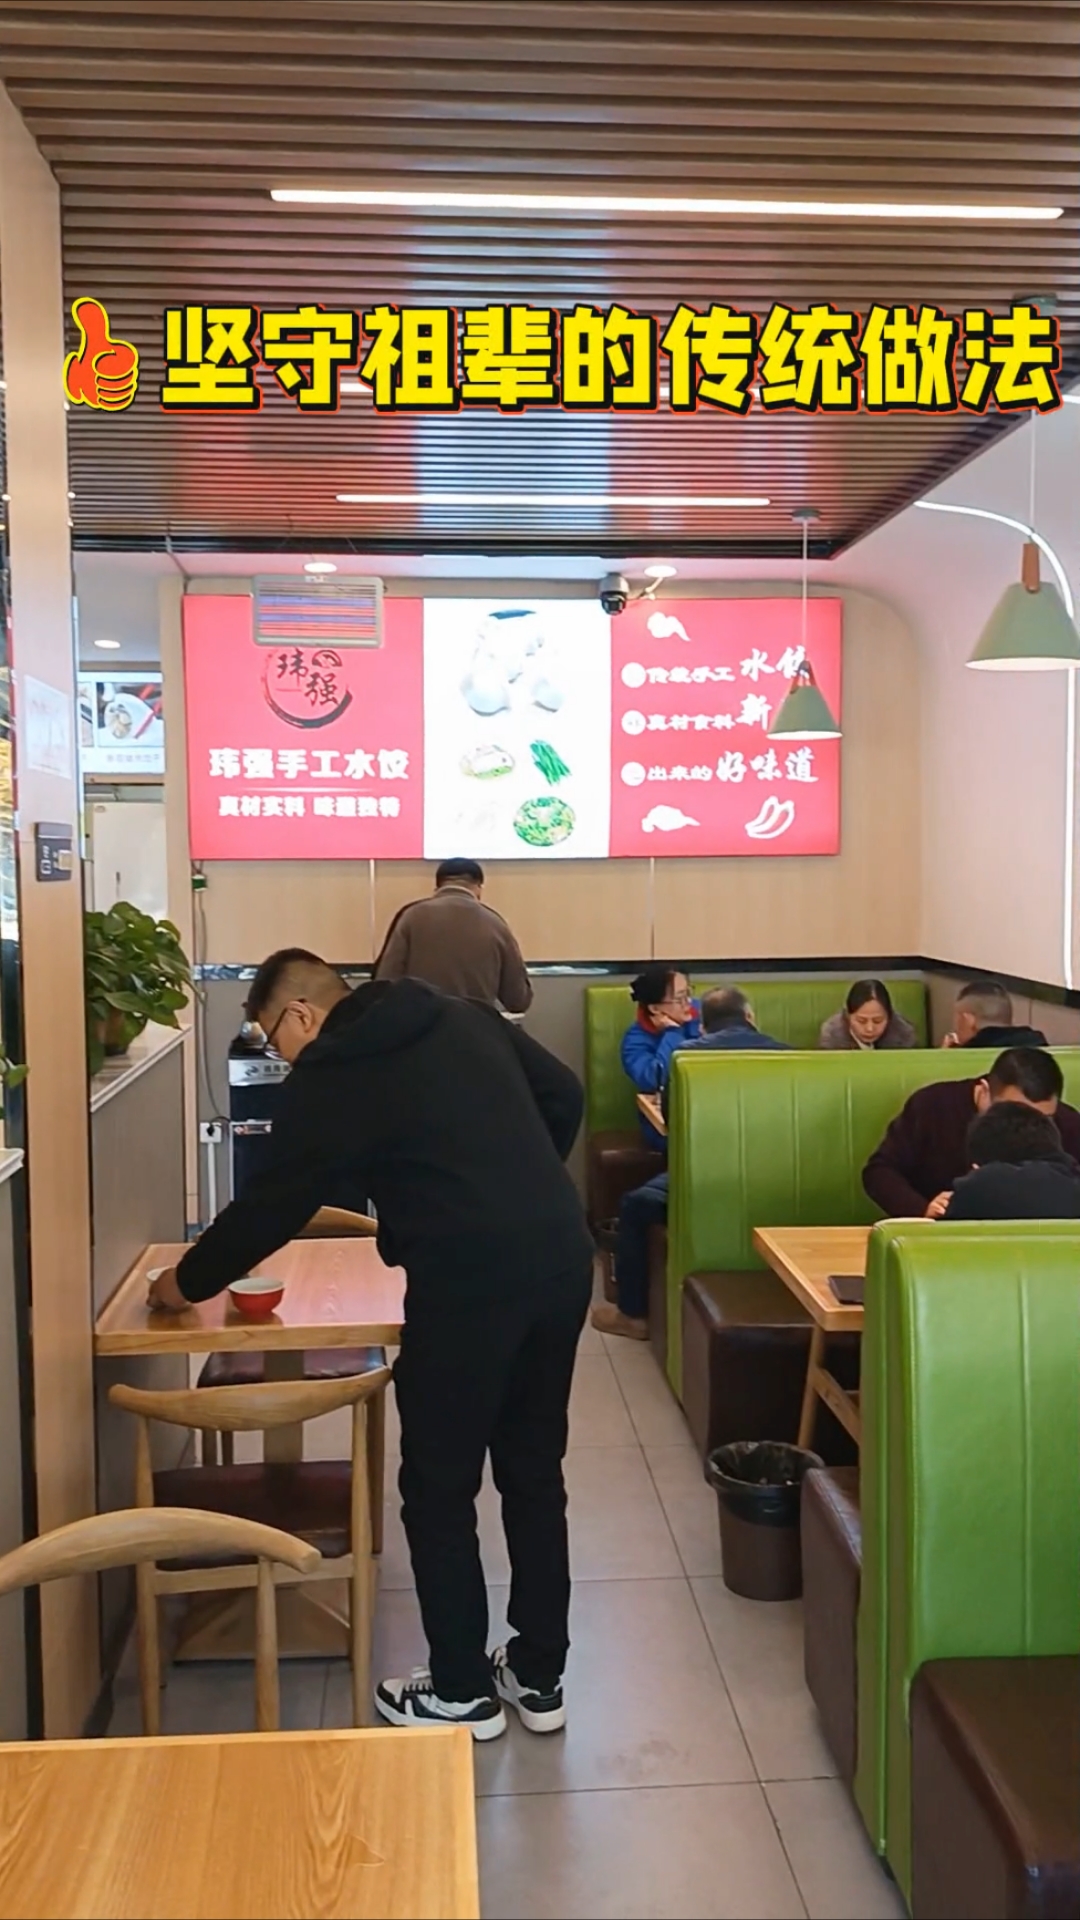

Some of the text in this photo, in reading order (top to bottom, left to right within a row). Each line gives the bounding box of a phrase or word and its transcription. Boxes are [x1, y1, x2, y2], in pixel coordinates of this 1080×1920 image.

[208, 747, 410, 780] 玮强手工水饺
